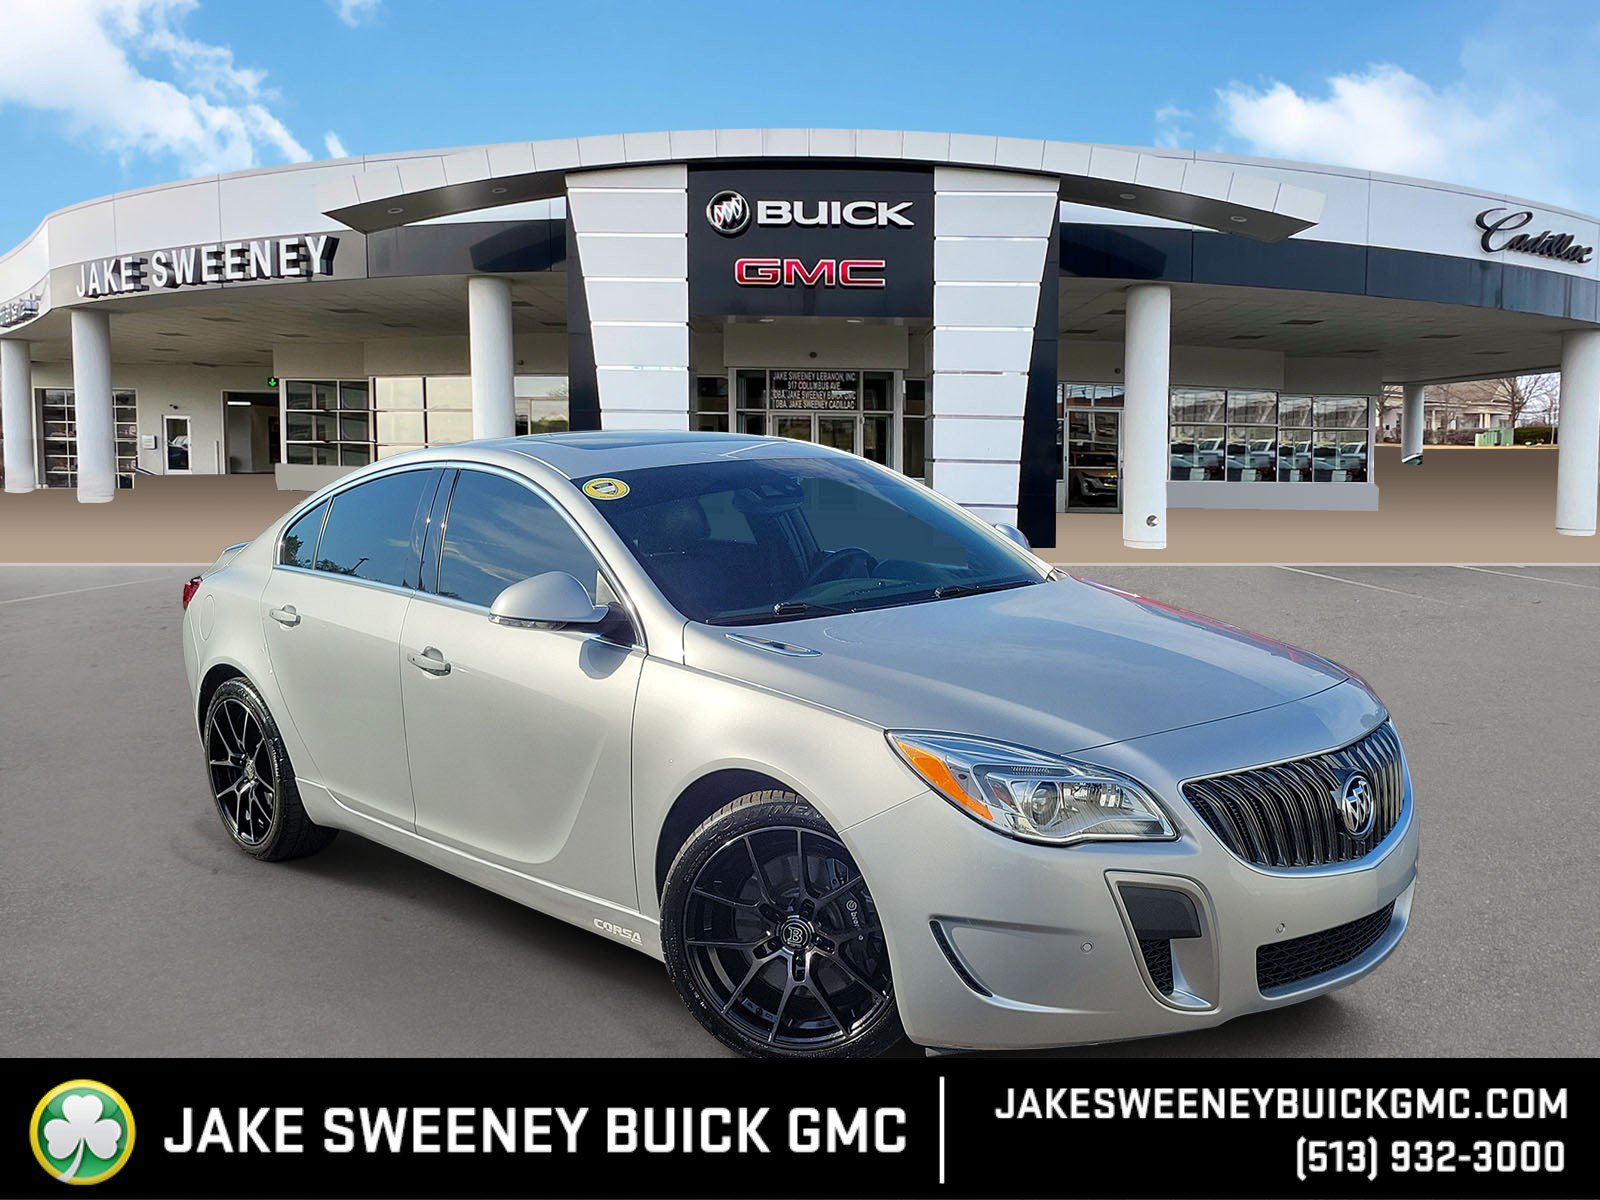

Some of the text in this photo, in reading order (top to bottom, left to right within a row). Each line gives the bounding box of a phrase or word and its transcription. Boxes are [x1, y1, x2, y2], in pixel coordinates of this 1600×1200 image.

[757, 200, 915, 227] BUICK
[1475, 207, 1593, 263] Cadillac
[75, 234, 335, 299] JAKE SWEENEY
[735, 258, 886, 287] GMC
[773, 371, 787, 380] JAKE
[788, 371, 815, 380] SWEENEY
[802, 390, 826, 399] SWEENEY
[803, 400, 827, 409] SWEENEY
[593, 918, 643, 946] CORSA
[787, 926, 803, 945] B
